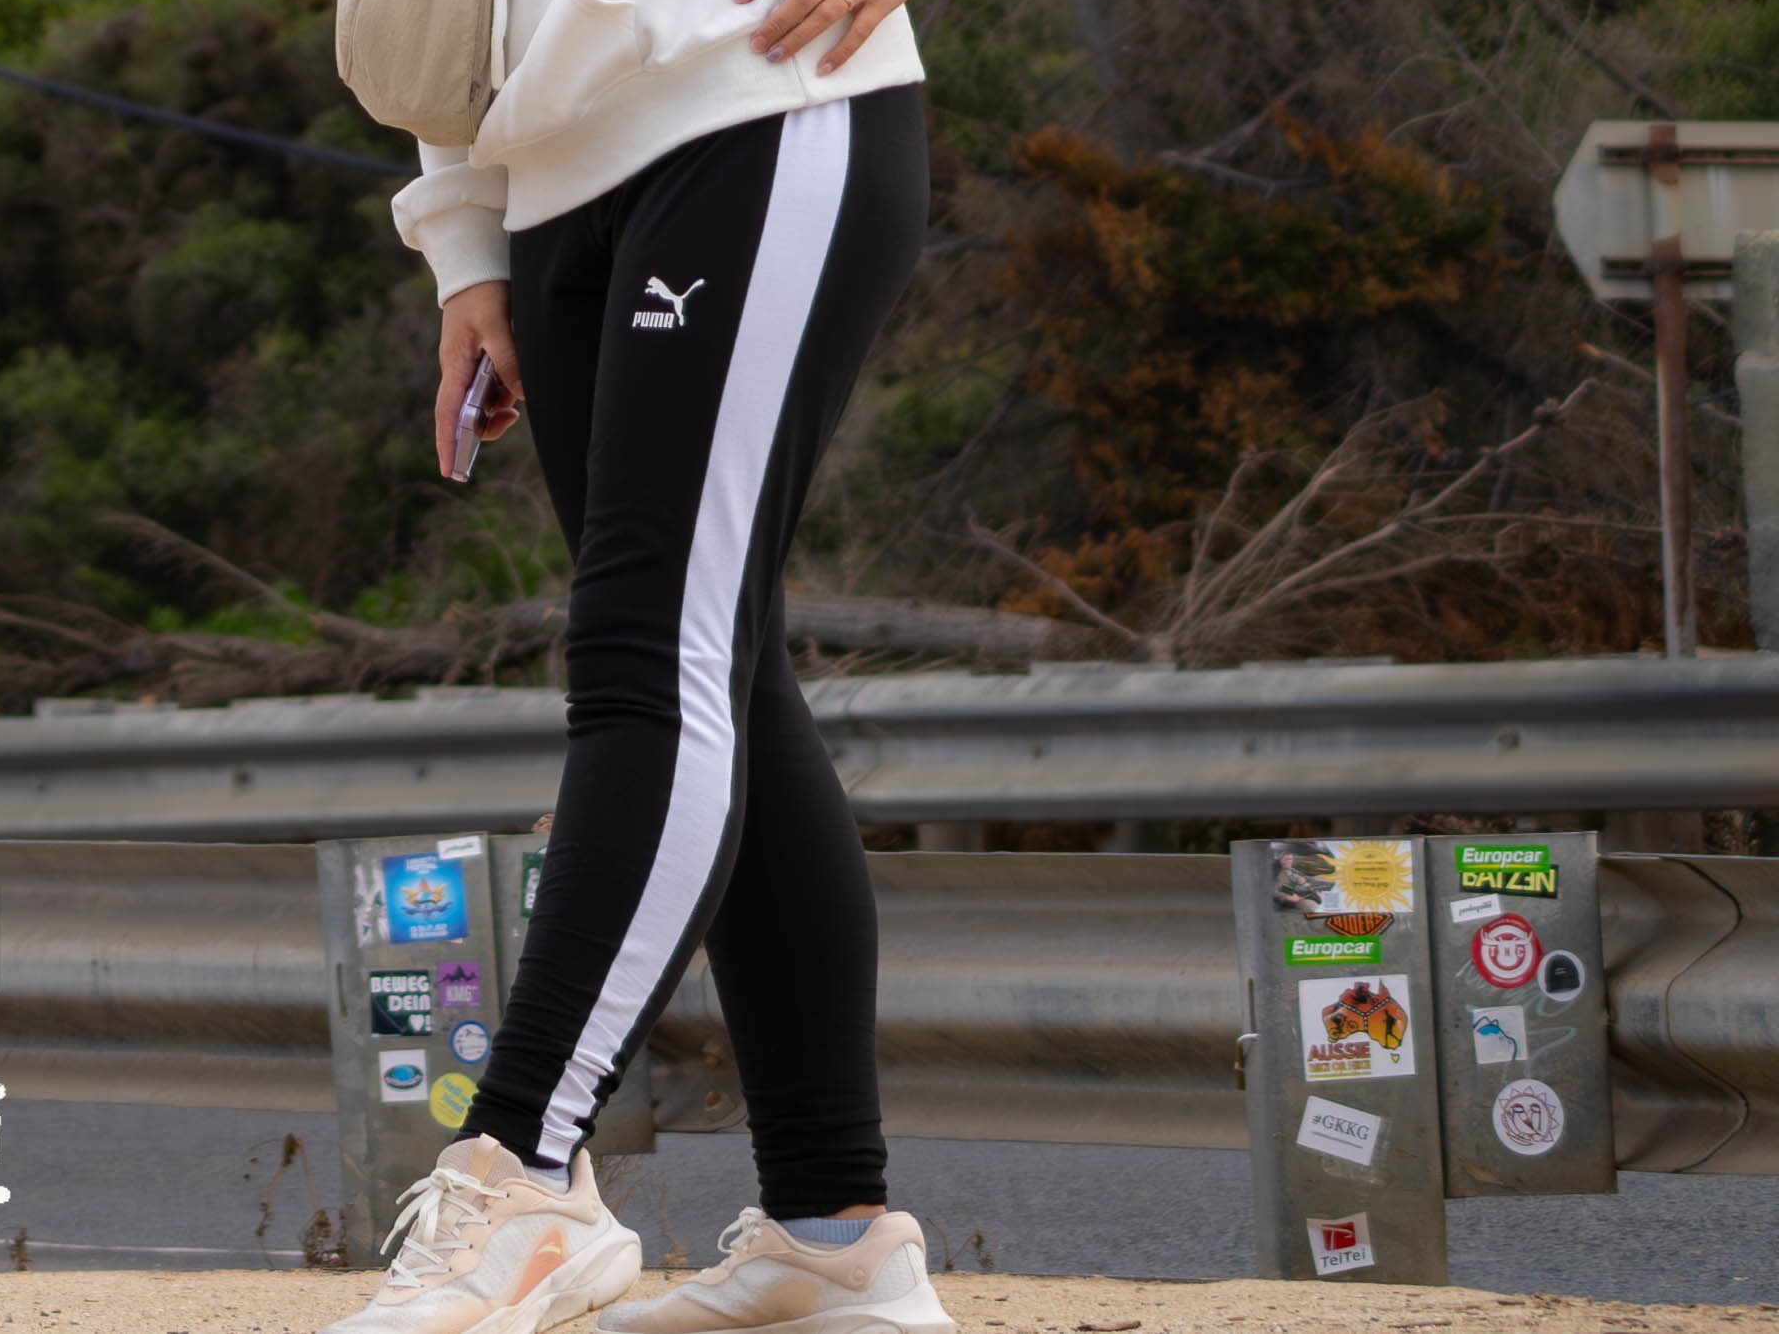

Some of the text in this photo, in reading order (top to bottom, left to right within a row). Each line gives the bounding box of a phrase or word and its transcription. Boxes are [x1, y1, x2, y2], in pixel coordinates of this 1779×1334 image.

[632, 312, 675, 329] PUMA
[1462, 847, 1543, 869] Europcar
[1292, 939, 1374, 960] Europcar
[370, 975, 430, 993] BEWEG
[1307, 1041, 1371, 1062] AUSSIE
[1312, 1114, 1370, 1141] #GKKG
[1320, 1247, 1366, 1269] TeiTei
